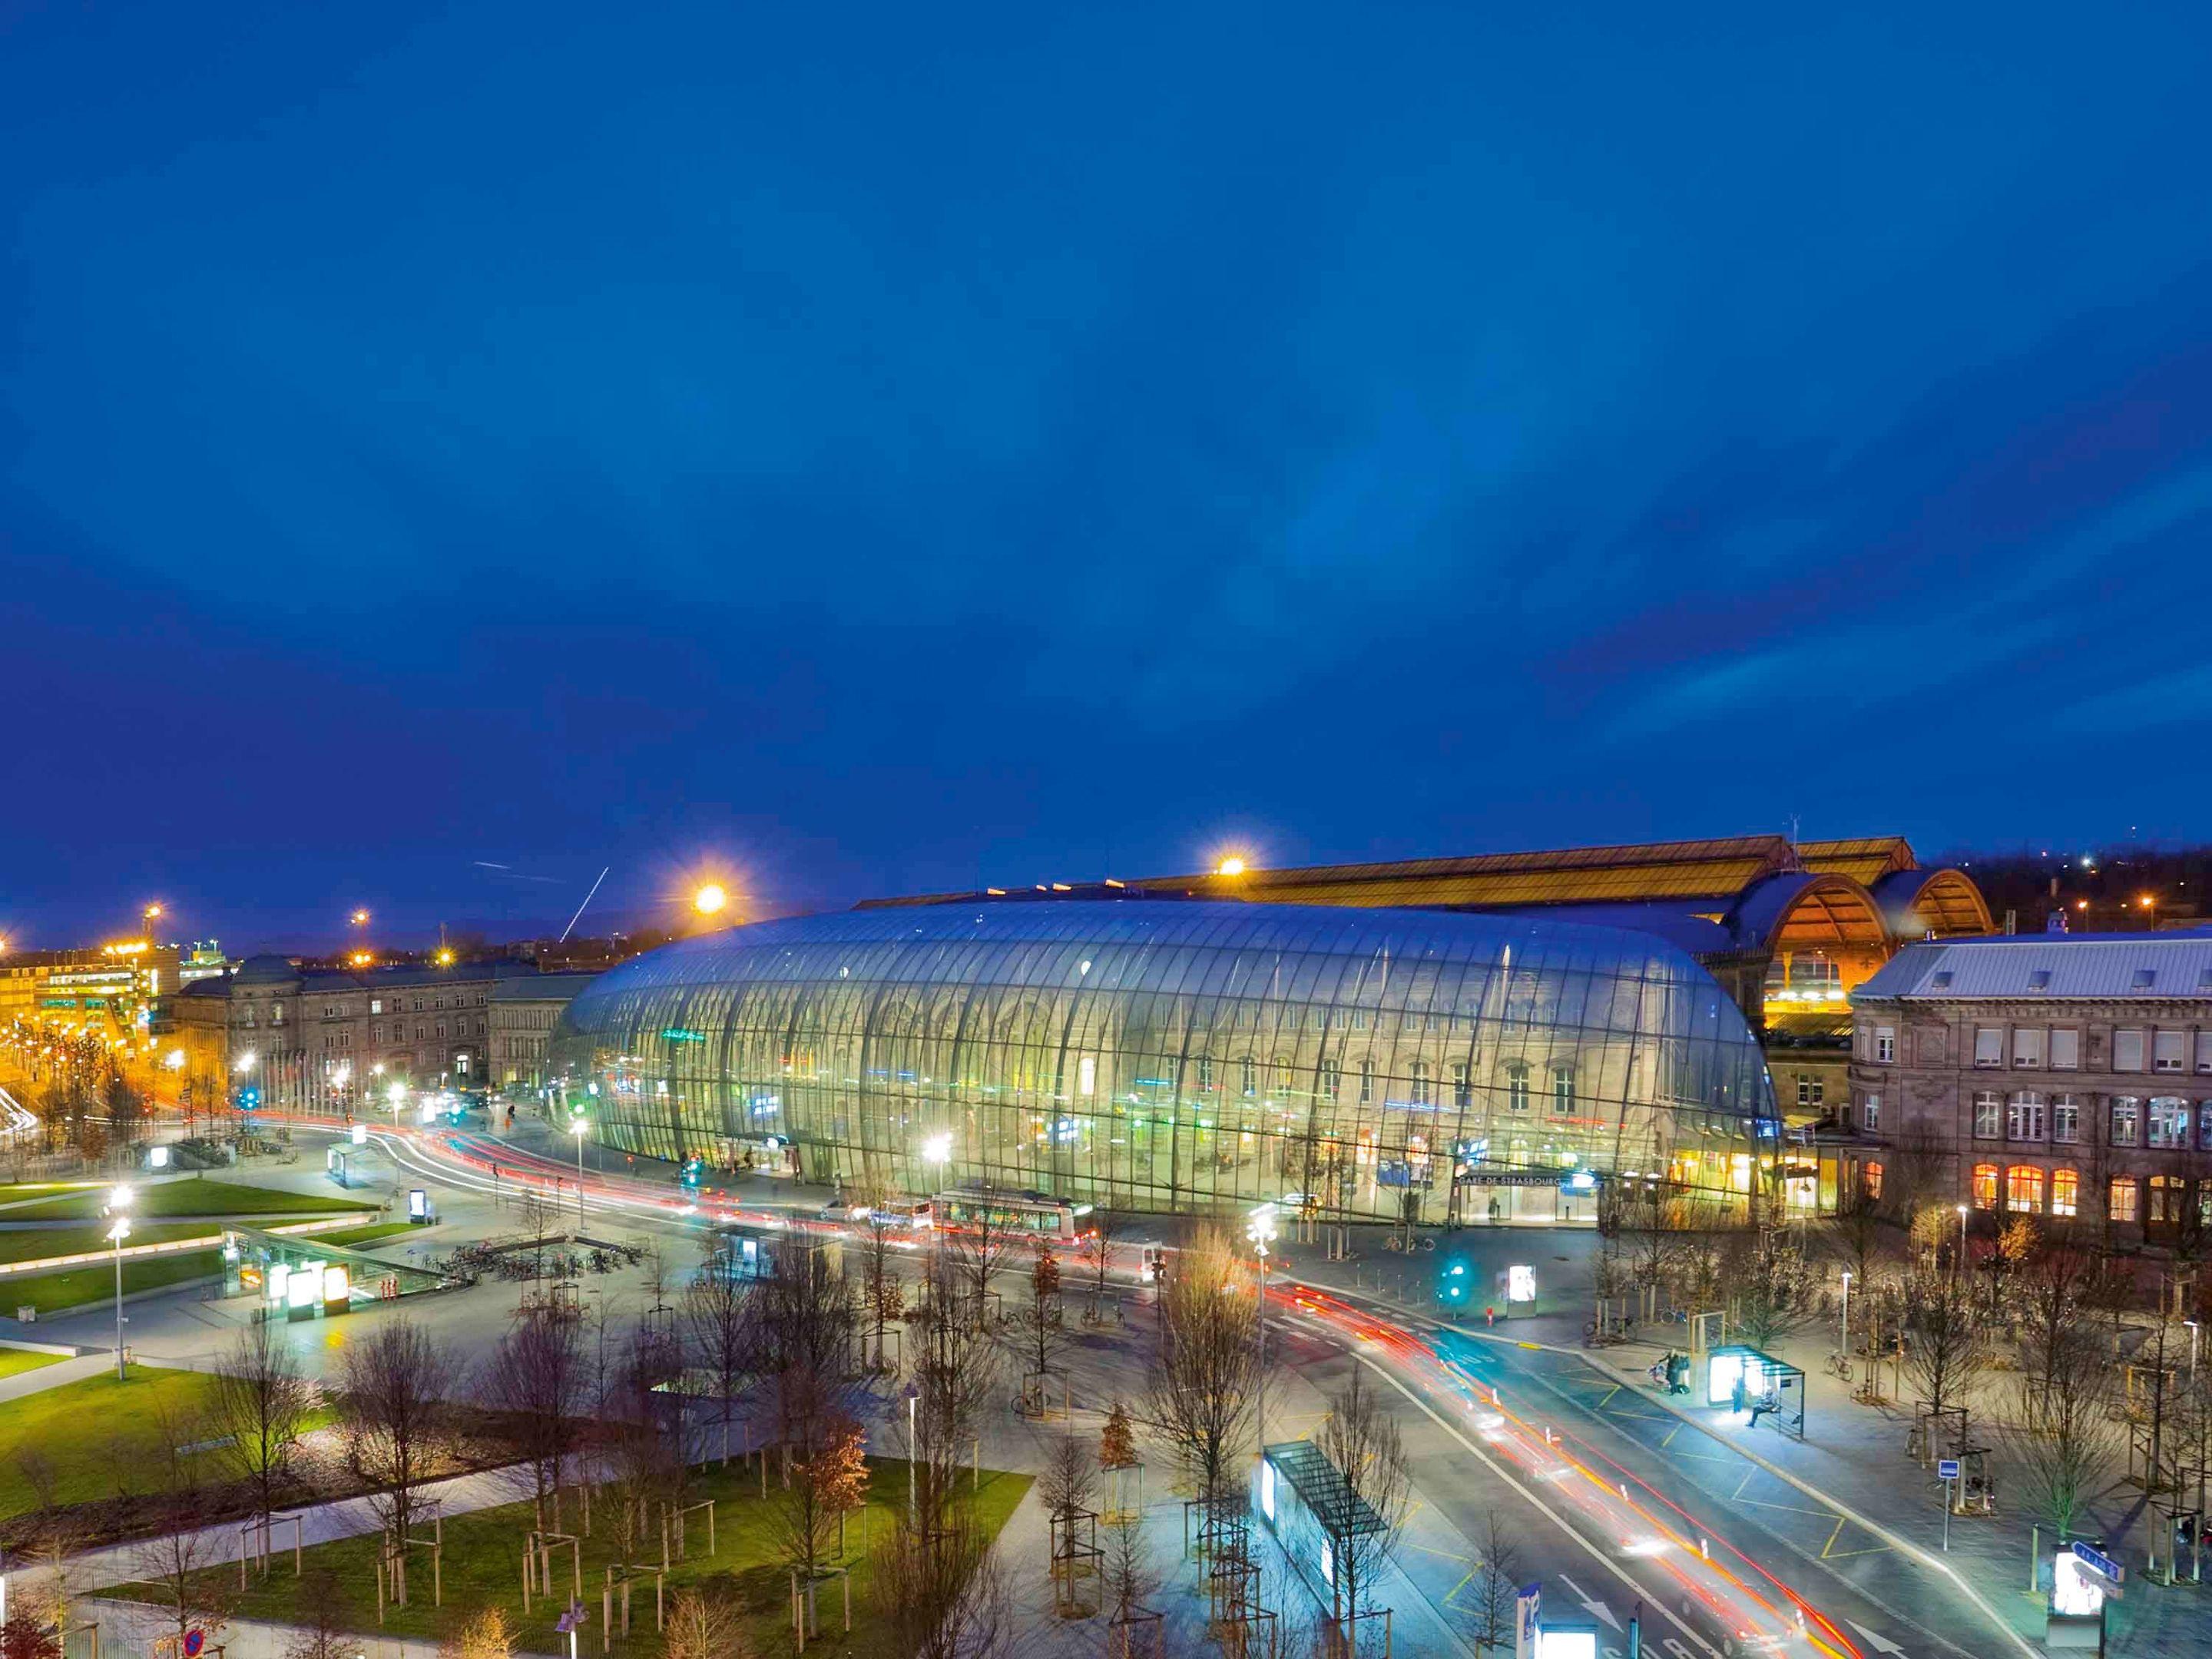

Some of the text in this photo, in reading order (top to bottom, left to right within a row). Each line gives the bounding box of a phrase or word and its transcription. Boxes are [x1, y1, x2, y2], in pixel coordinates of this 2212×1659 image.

[1459, 1176, 1561, 1187] GARE DE STRASBOURG
